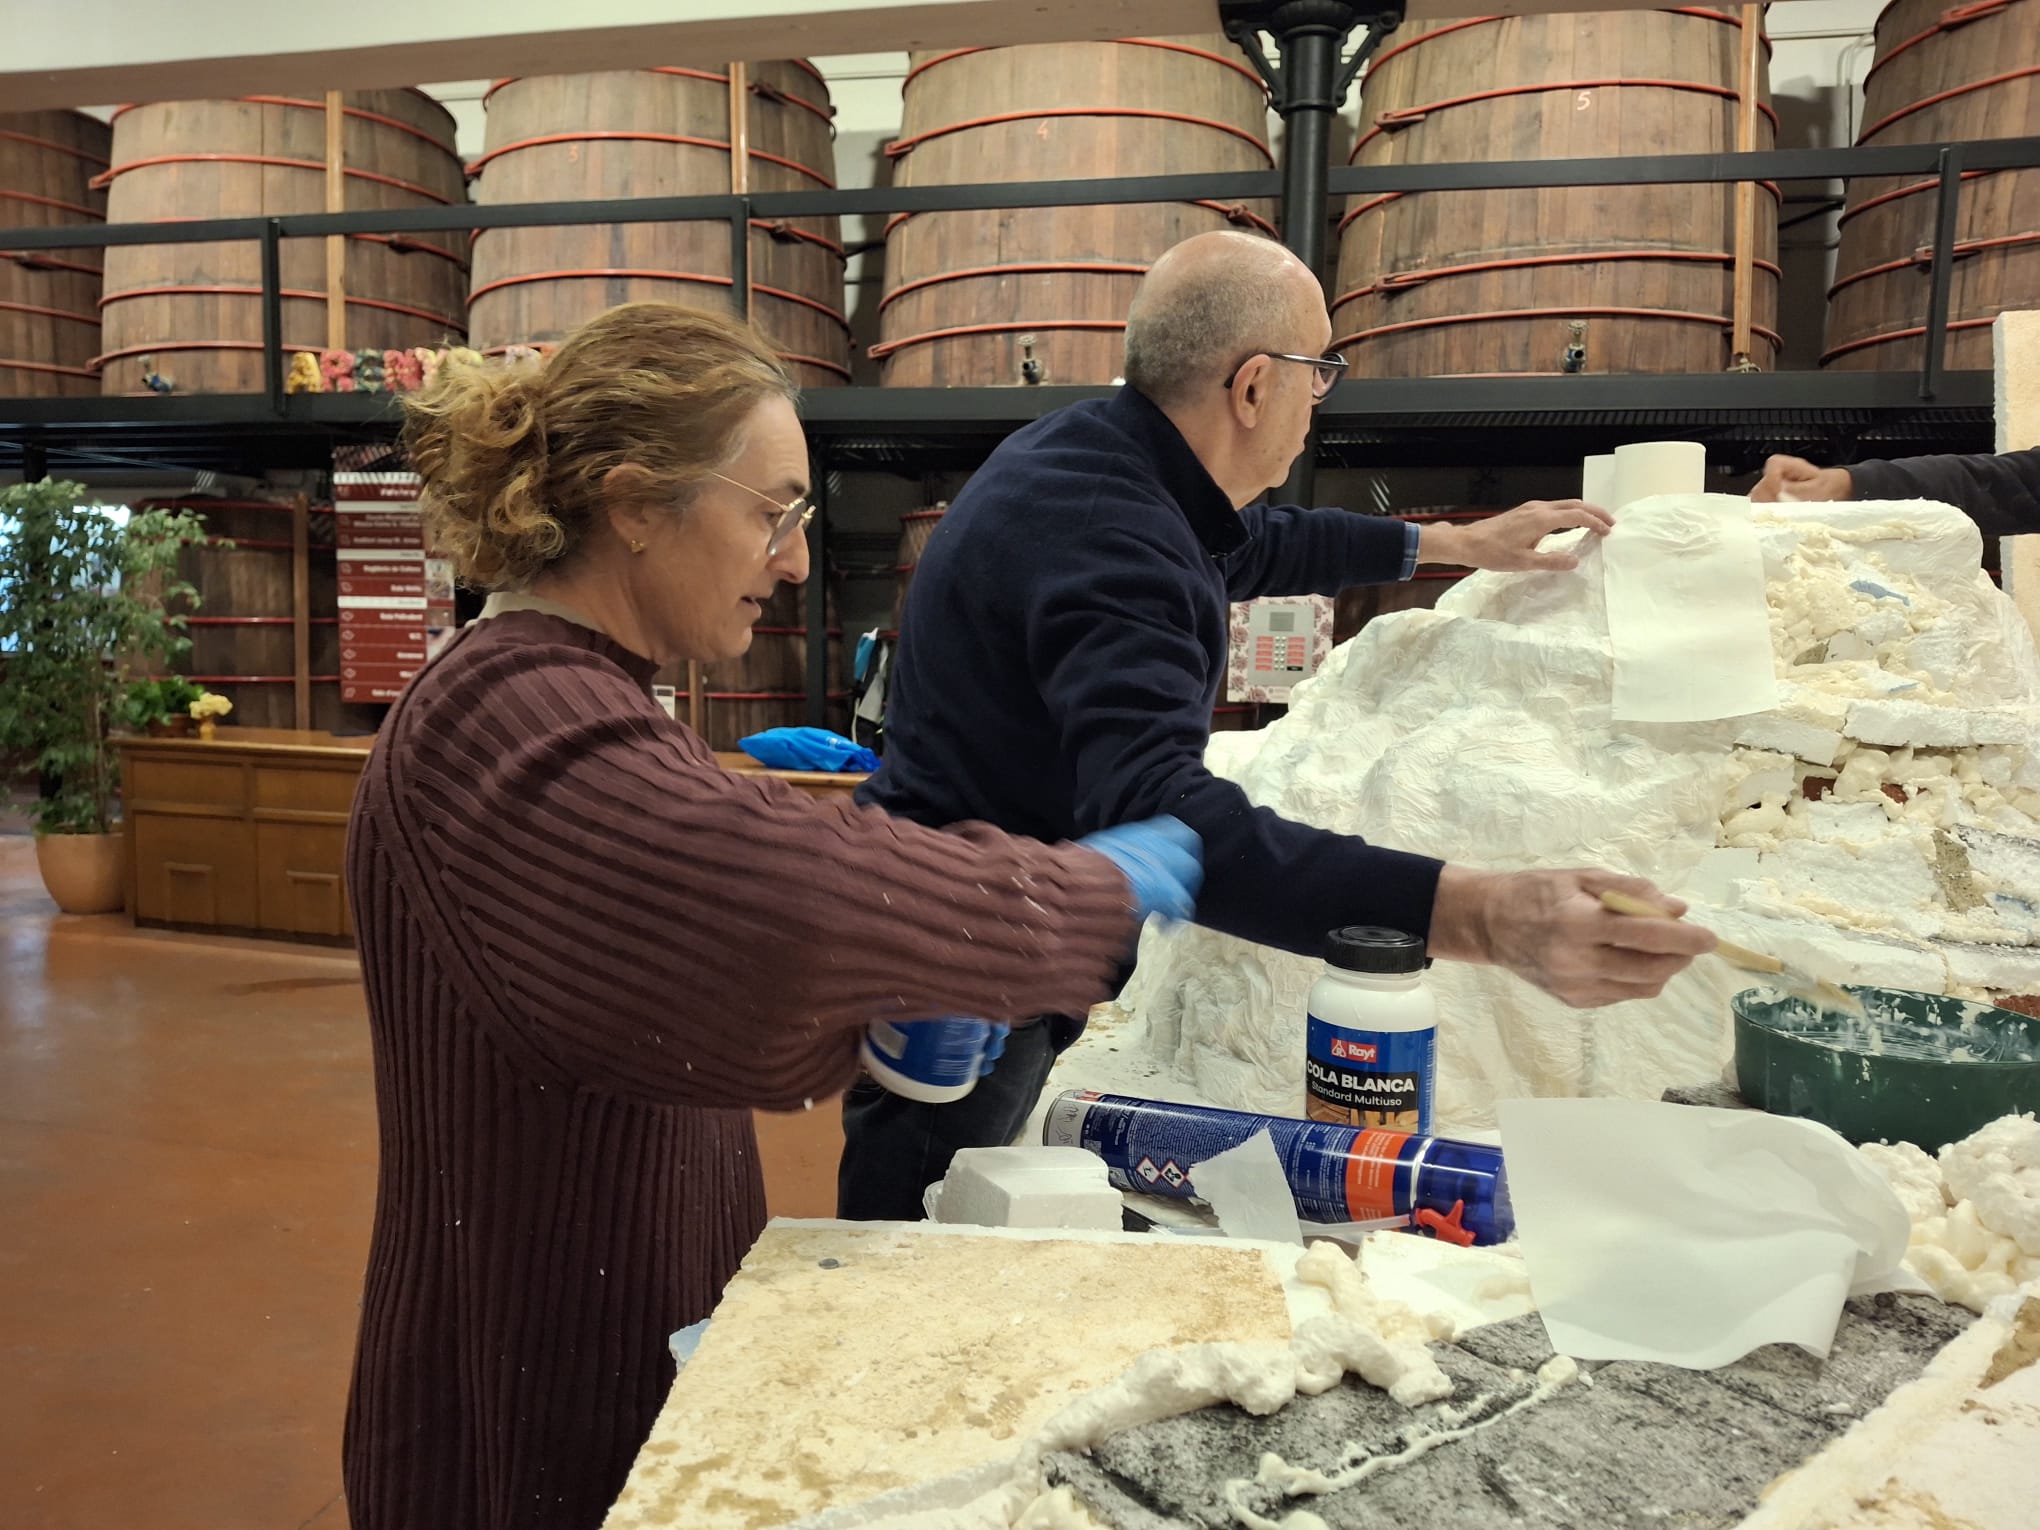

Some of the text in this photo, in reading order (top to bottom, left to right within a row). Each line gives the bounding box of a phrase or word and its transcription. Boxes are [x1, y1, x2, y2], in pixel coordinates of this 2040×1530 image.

[1577, 91, 1591, 110] 5
[1037, 119, 1048, 139] 4
[1348, 1044, 1376, 1060] Rayt
[1307, 1060, 1415, 1092] COLA BLANCA
[1311, 1081, 1402, 1106] Standard Multiuso
